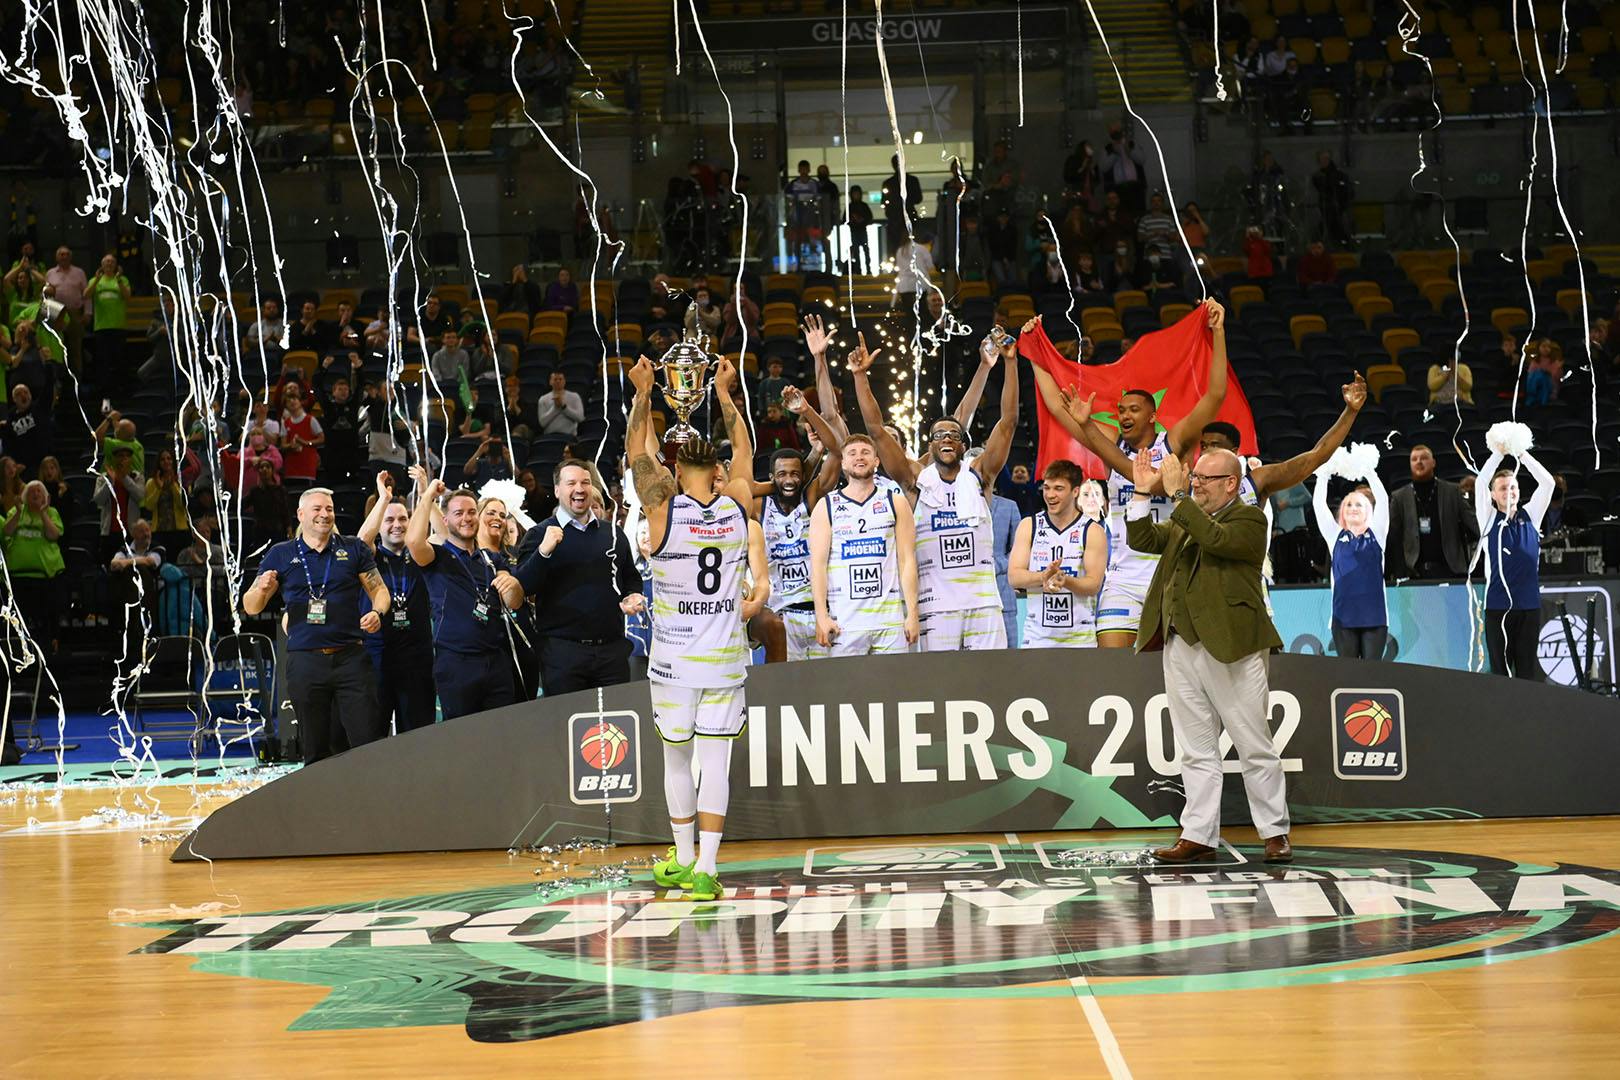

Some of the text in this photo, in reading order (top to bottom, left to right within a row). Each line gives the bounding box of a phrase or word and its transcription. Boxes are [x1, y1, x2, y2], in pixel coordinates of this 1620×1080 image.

[811, 19, 942, 42] GLASGOW
[689, 526, 735, 536] Wirral Cars
[785, 524, 794, 539] 5
[858, 518, 867, 534] 2
[844, 544, 885, 557] PHOENIX
[944, 537, 970, 550] HM
[945, 553, 971, 563] Legal
[1050, 545, 1064, 561] 10
[697, 546, 723, 596] 8
[782, 567, 805, 579] HM
[853, 568, 879, 580] HM
[854, 584, 880, 595] Legal
[1045, 597, 1069, 609] HM
[1046, 612, 1069, 624] Legal
[730, 697, 1053, 787] INNERS
[1342, 751, 1399, 767] BBL
[577, 774, 633, 792] BBL
[943, 866, 1412, 890] BASKETBALL
[166, 886, 1093, 954] TROPHY
